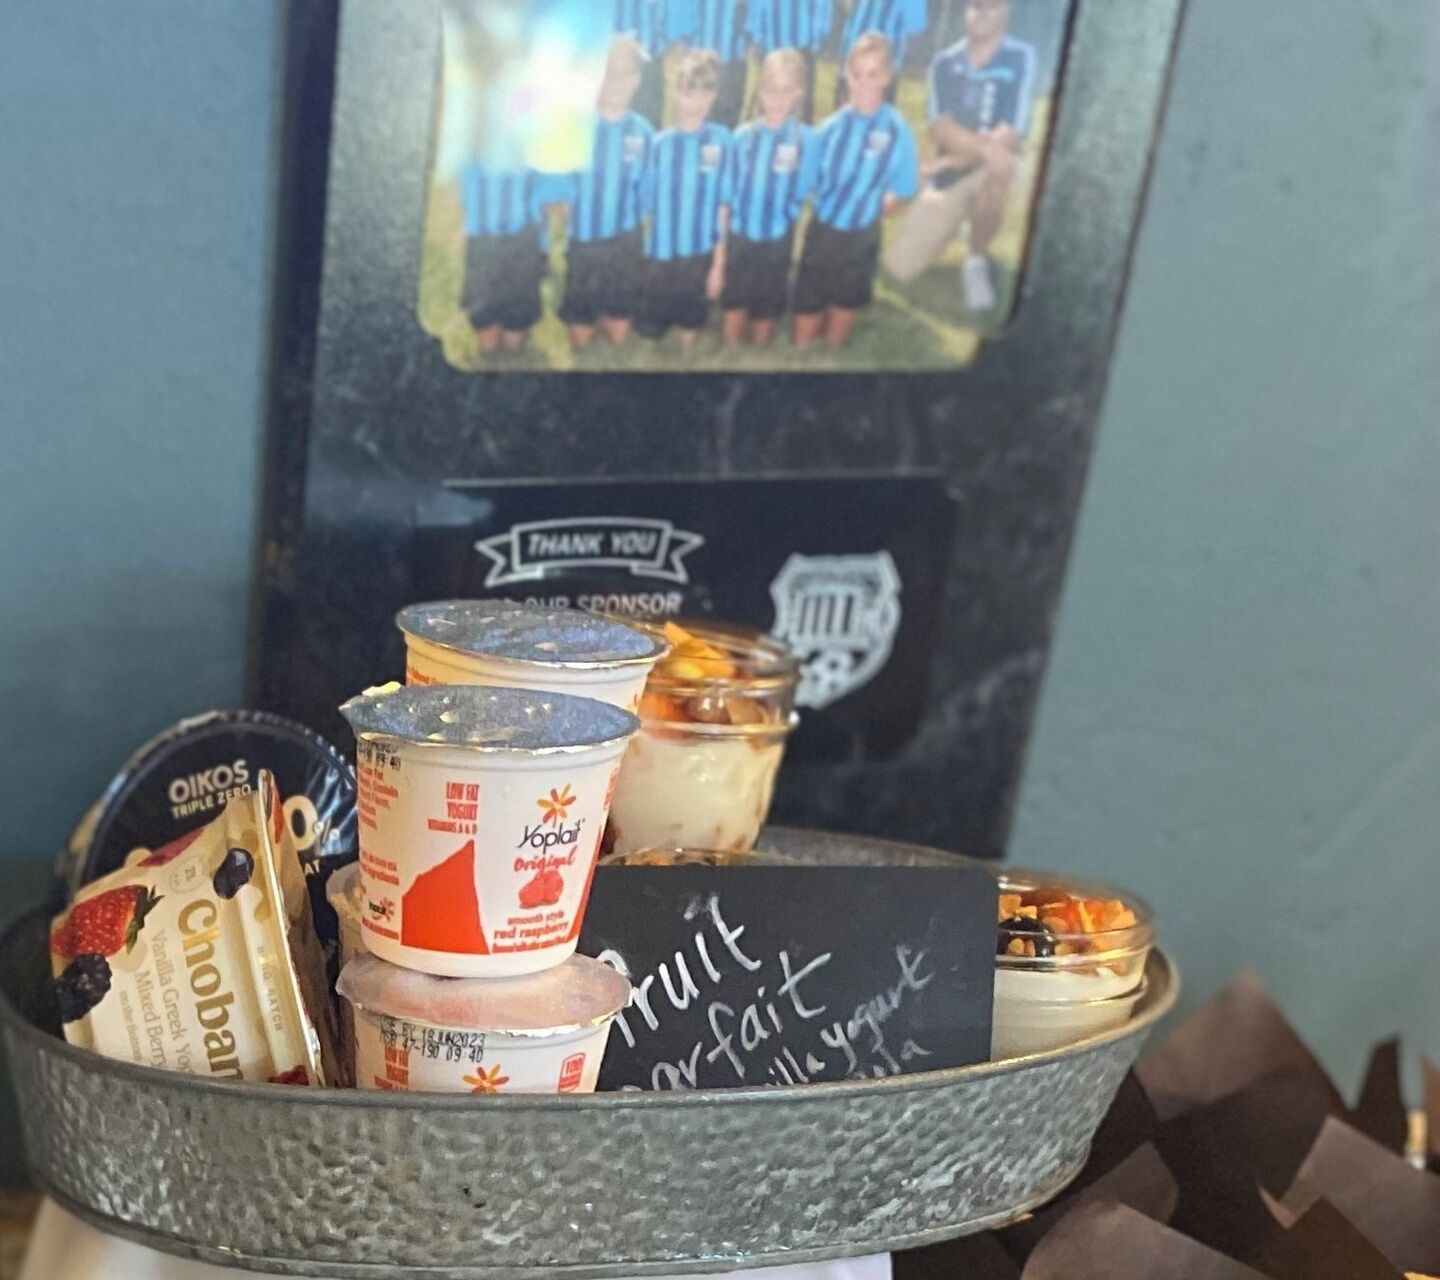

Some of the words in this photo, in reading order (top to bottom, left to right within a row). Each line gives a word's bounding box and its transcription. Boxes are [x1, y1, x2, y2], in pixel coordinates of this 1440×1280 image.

[526, 531, 604, 556] THANK
[609, 531, 657, 556] YOU
[168, 759, 249, 804] OIKOS
[171, 794, 214, 819] TRIPLE
[217, 783, 251, 805] ZERO
[513, 845, 578, 876] Original
[517, 819, 582, 855] Yoplait
[151, 927, 176, 987] Vanilla
[135, 969, 160, 1024] Mixed
[177, 898, 244, 1080] Choban
[162, 987, 188, 1042] Greek
[622, 951, 832, 1091] arfait
